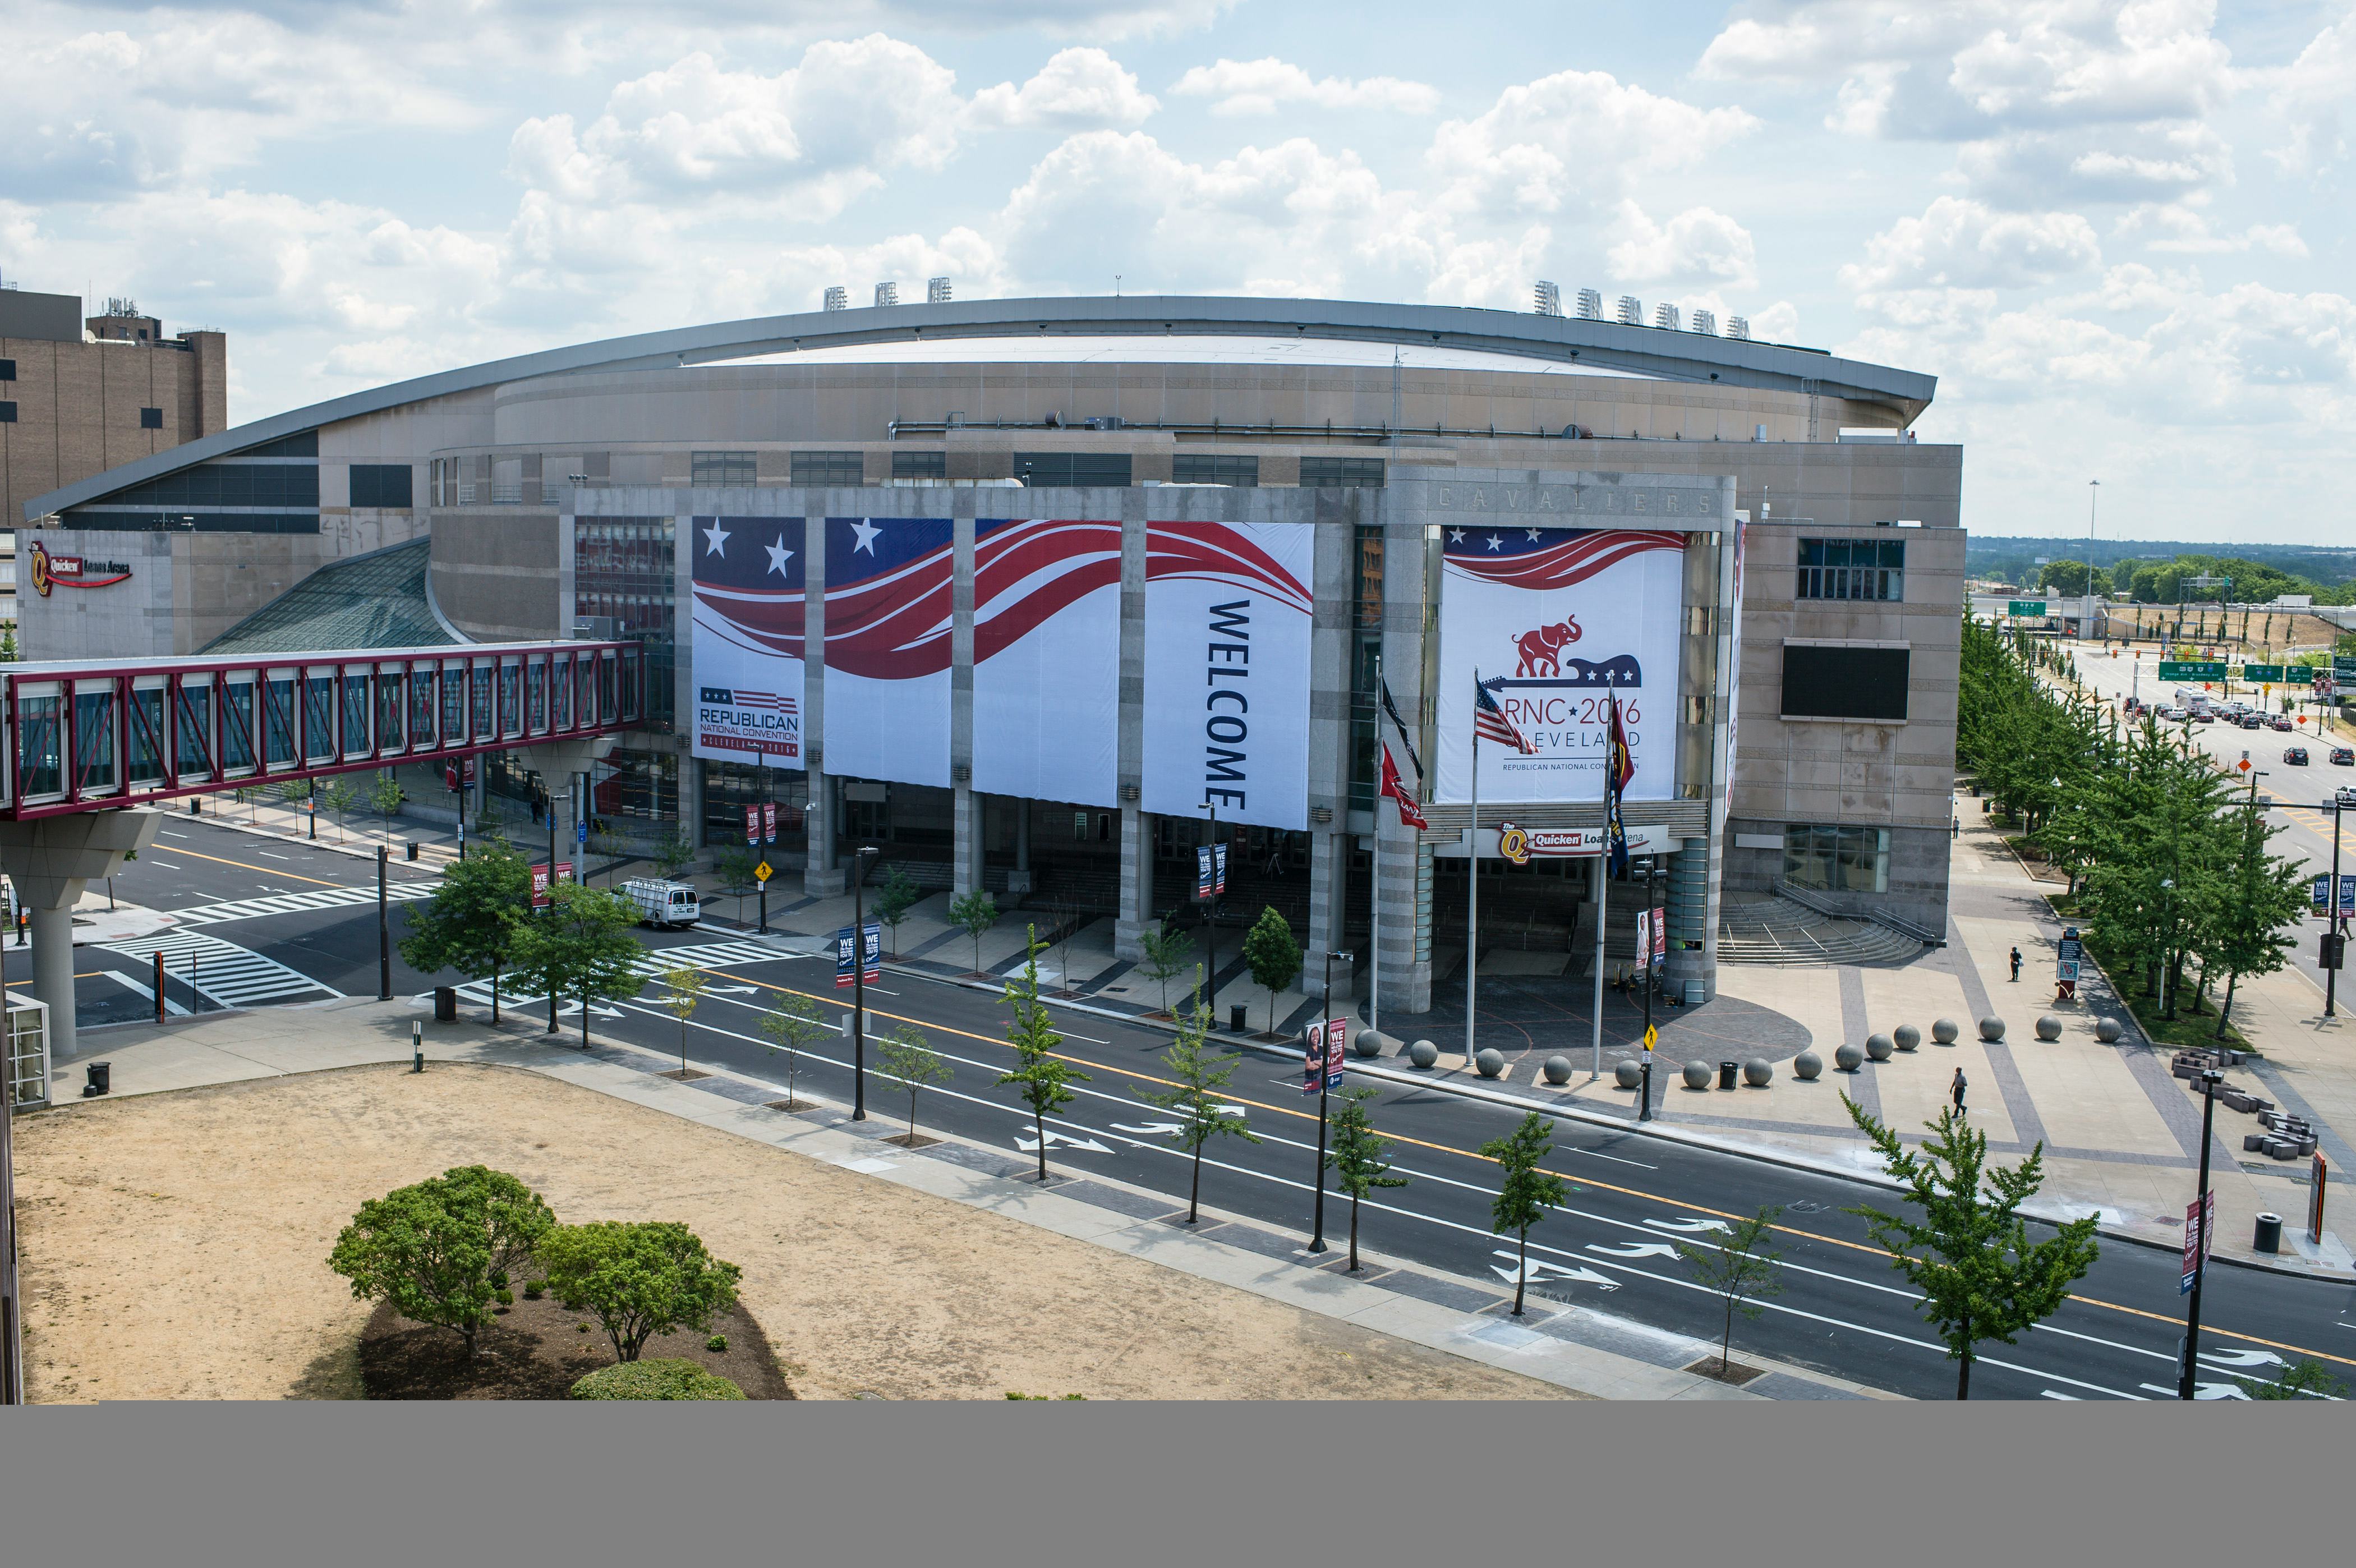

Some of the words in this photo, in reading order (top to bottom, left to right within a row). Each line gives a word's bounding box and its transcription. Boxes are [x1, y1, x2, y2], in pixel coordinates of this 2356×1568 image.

[1439, 486, 1710, 513] CAVALIERS
[50, 559, 79, 573] Quicken
[84, 560, 106, 573] Loans
[107, 560, 130, 574] Arena
[1205, 599, 1250, 810] WELCOME
[1505, 698, 1566, 725] RNC
[1580, 698, 1641, 724] 2016
[701, 709, 798, 732] REPUBLICAN
[701, 724, 740, 735] NATIONAL
[743, 728, 798, 741] CONVENTION
[1506, 732, 1640, 748] EVELAD
[769, 743, 790, 753] 2016
[1502, 829, 1531, 864] Q
[1535, 834, 1580, 845] Quicken
[1216, 852, 1225, 861] WE
[534, 873, 547, 882] WE
[558, 871, 570, 879] WE
[1655, 918, 1663, 927] WE
[840, 937, 853, 948] WE
[866, 934, 878, 944] WE
[1331, 1030, 1343, 1042] WE
[2206, 1205, 2213, 1221] WE
[2188, 1216, 2198, 1232] WE
